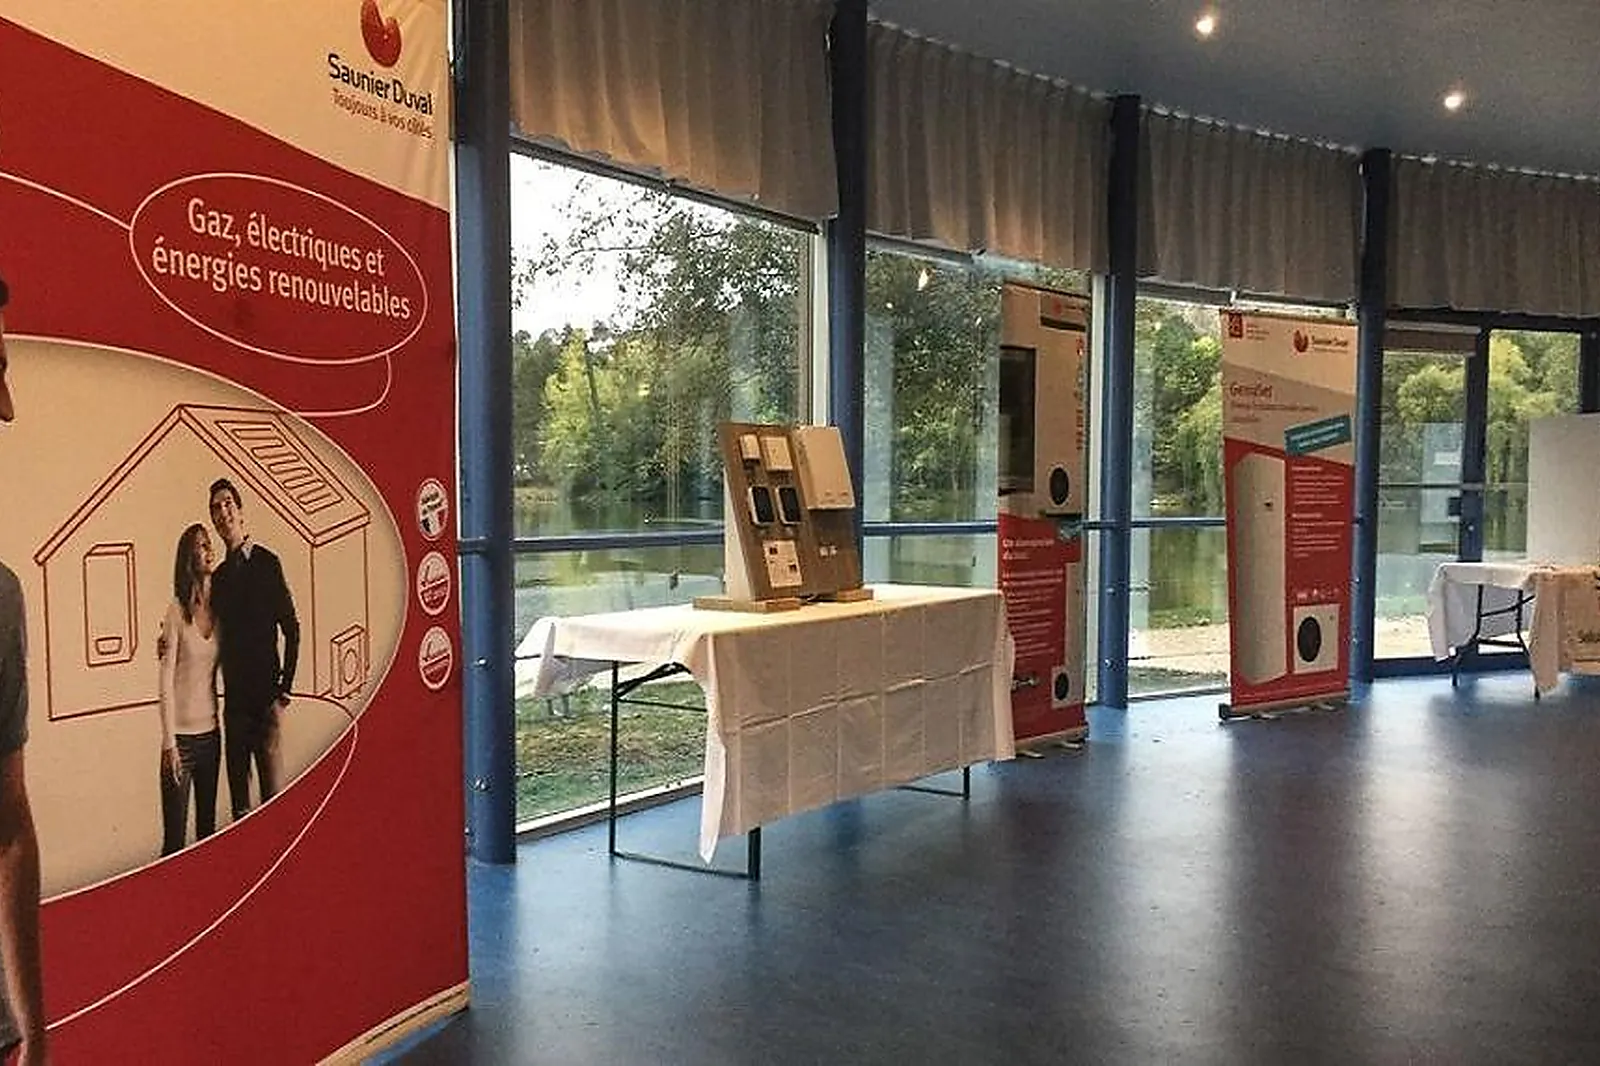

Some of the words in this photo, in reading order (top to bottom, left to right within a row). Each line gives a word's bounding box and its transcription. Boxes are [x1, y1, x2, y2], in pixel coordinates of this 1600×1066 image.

[328, 53, 390, 99] Saunier
[393, 79, 433, 115] Duval
[188, 198, 241, 247] Gaz,
[247, 212, 361, 271] électriques
[366, 248, 385, 277] et
[152, 236, 262, 292] énergies
[268, 268, 411, 320] renouvelables
